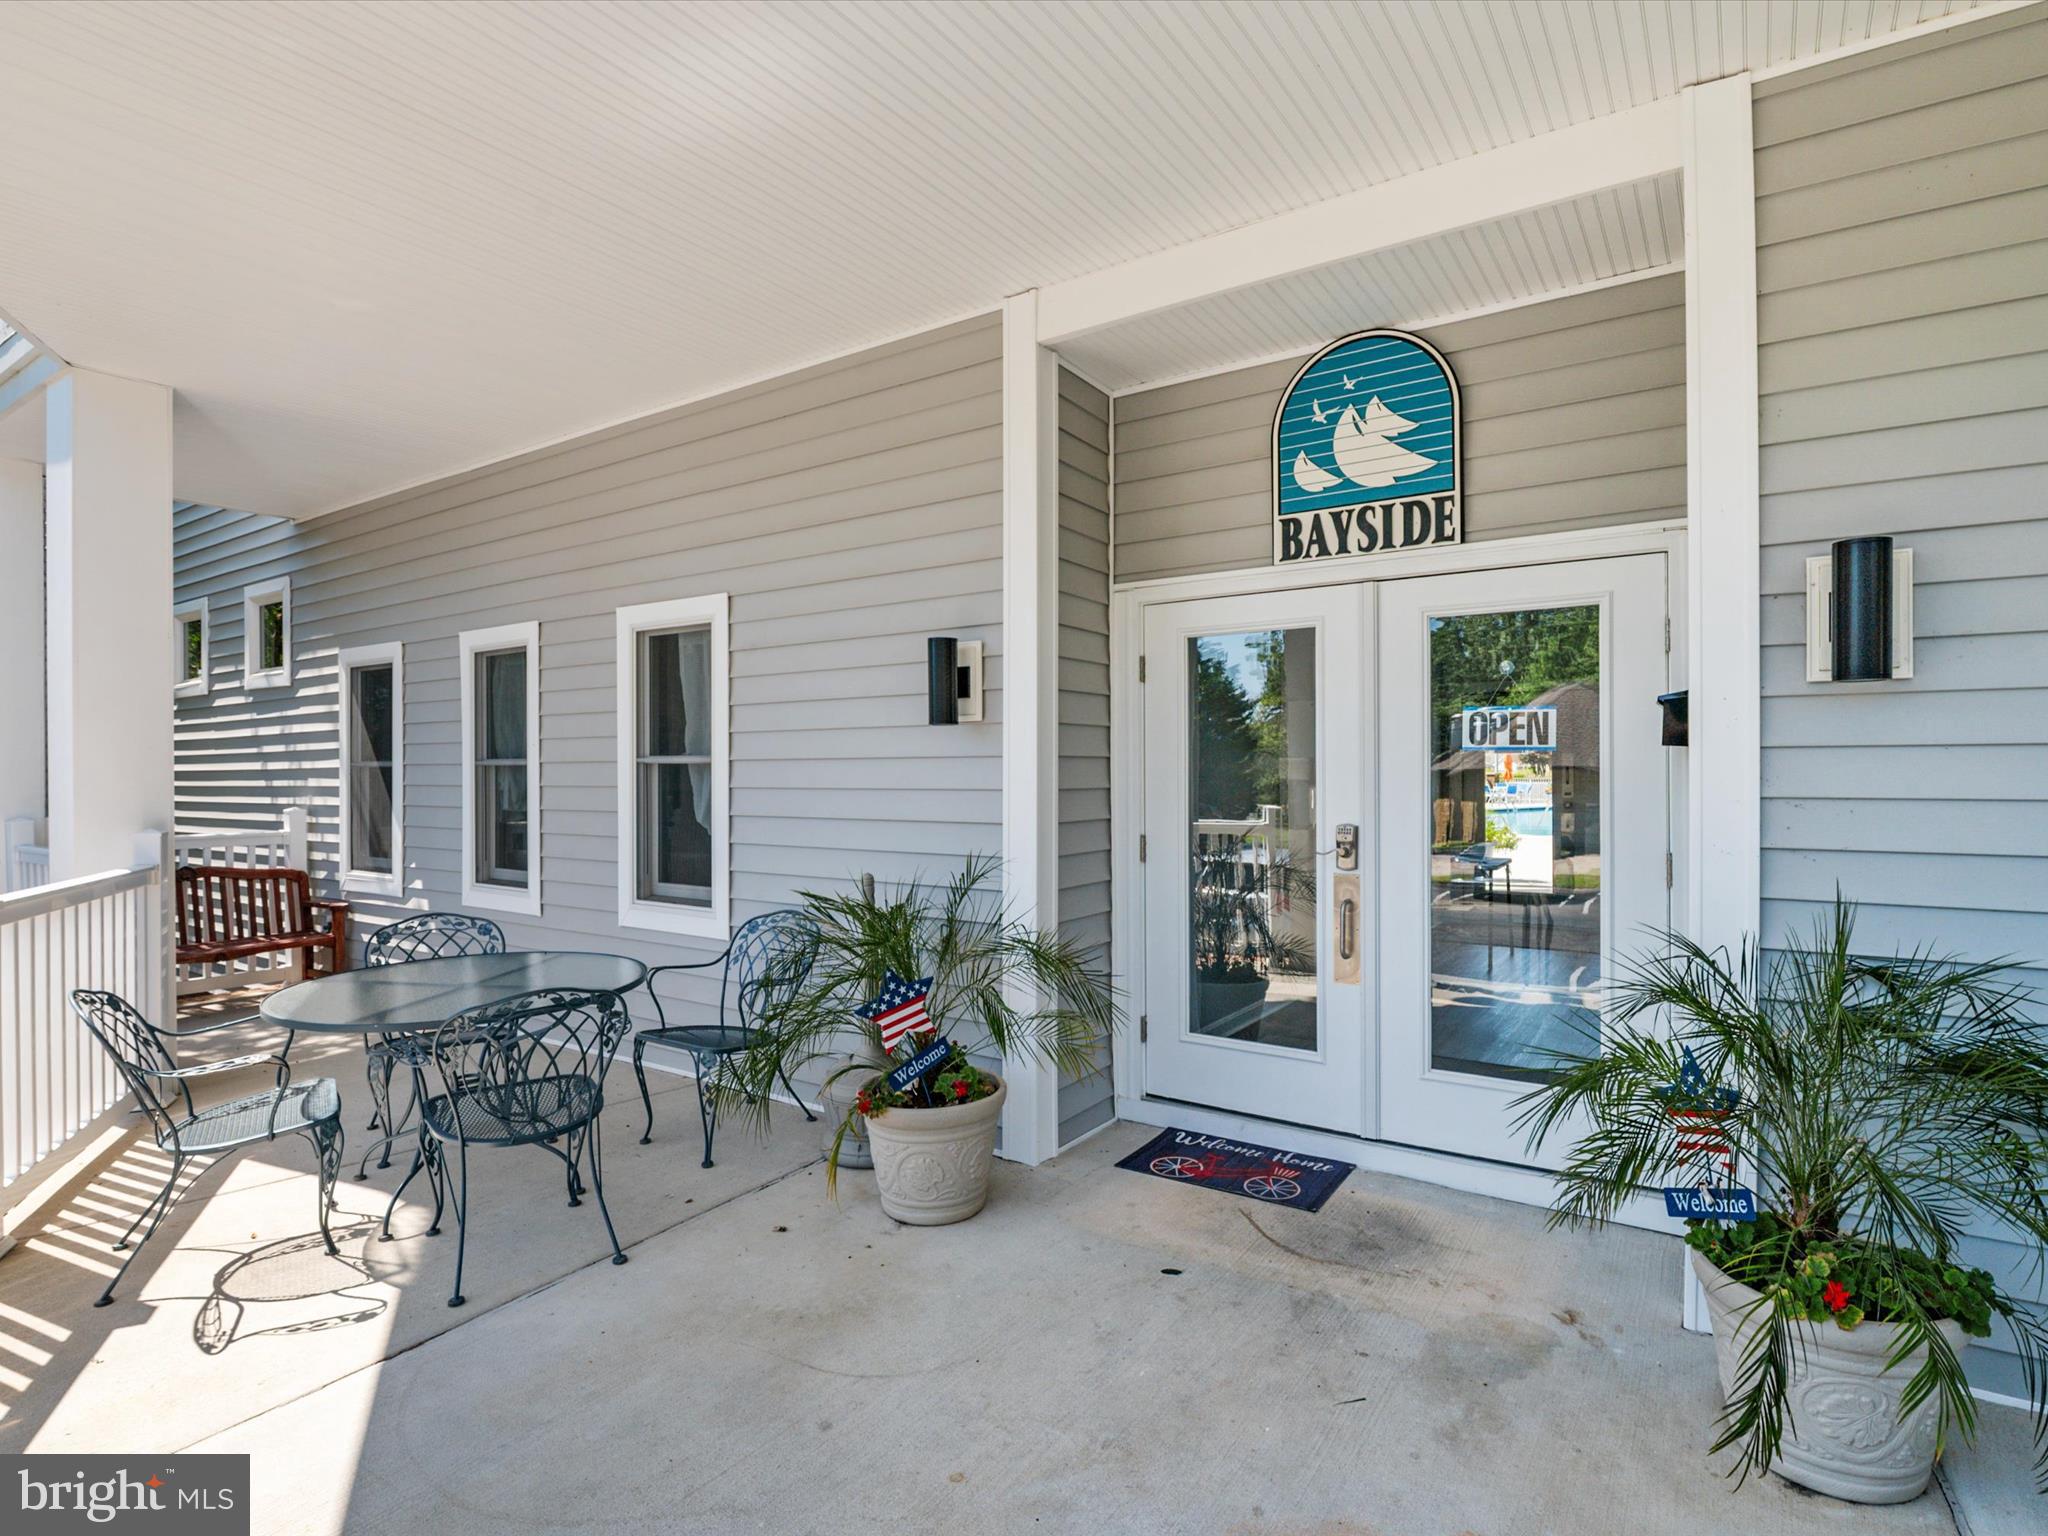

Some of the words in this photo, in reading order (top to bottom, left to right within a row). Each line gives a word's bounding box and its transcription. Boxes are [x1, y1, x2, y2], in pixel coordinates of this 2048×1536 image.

[1278, 494, 1456, 562] BAYSIDE
[1468, 711, 1550, 746] OPEN
[893, 1043, 947, 1084] Welcome
[1175, 1131, 1265, 1157] Welcome
[1271, 1151, 1336, 1173] Home
